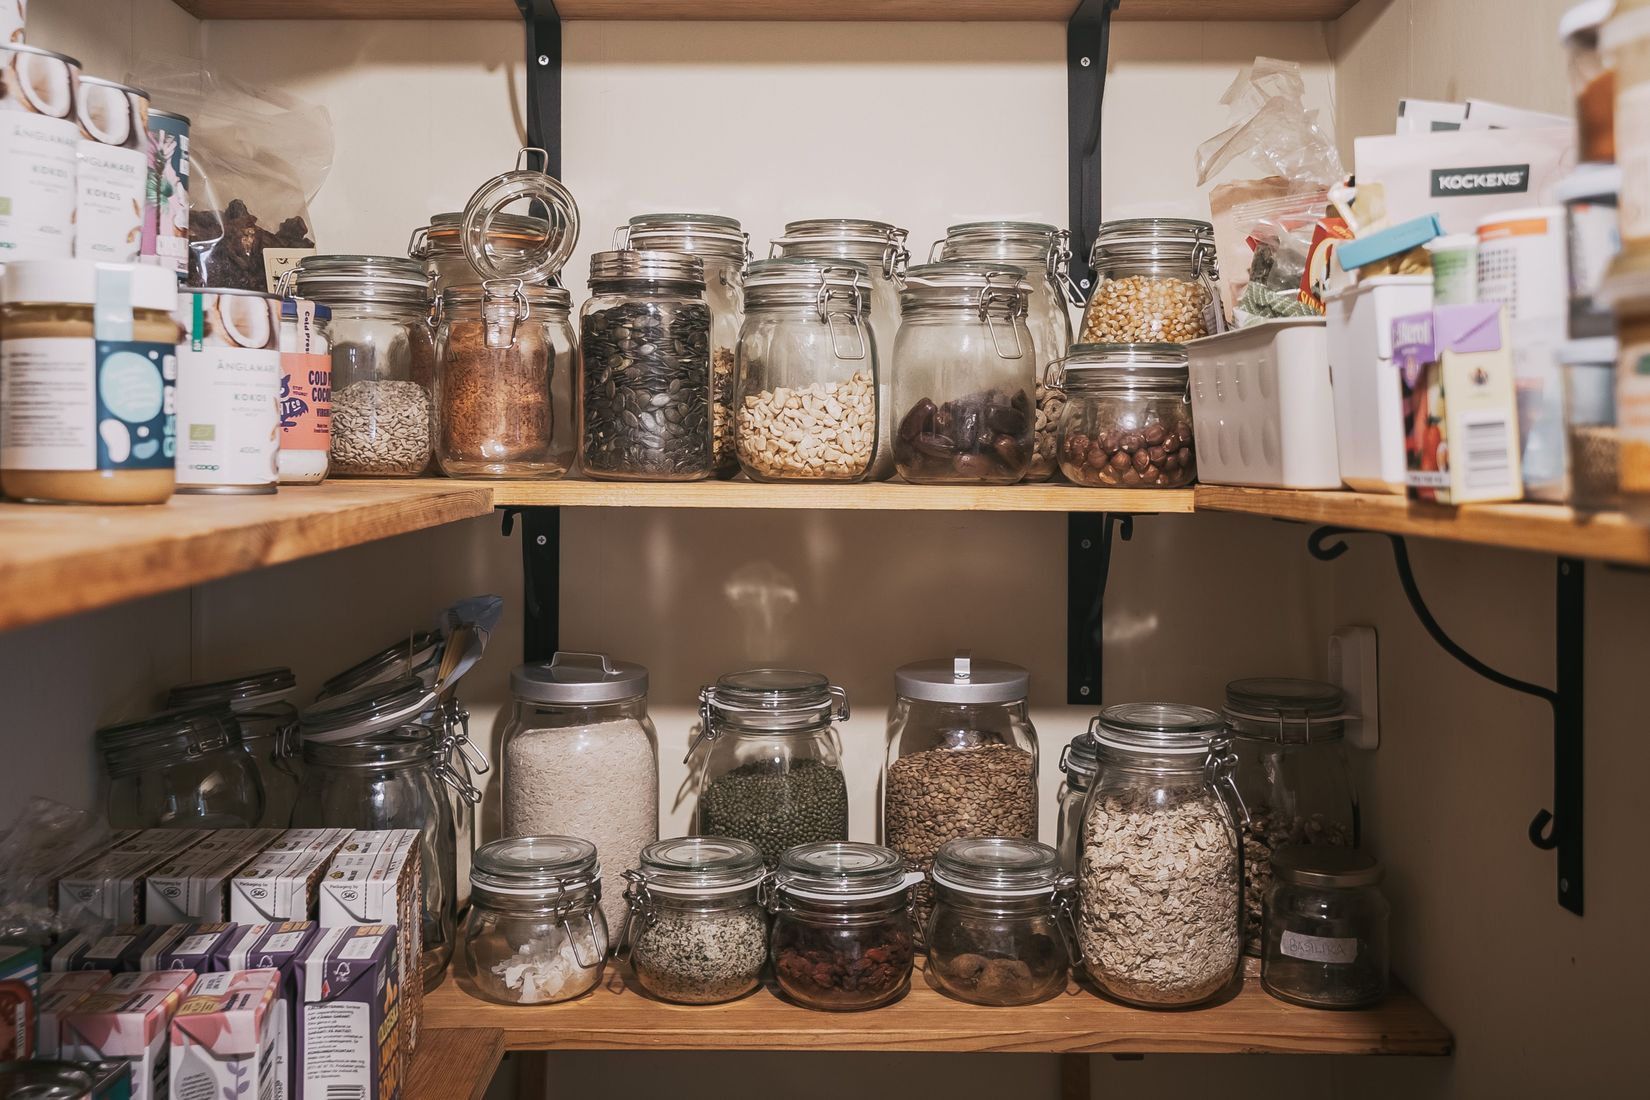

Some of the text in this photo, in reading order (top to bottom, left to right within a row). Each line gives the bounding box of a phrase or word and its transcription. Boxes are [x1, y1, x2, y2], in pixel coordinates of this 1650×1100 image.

[1438, 171, 1522, 190] KOCKENS
[86, 188, 121, 201] KOKOS
[304, 310, 312, 331] Cold
[308, 370, 328, 386] COLD
[251, 889, 265, 897] SIG
[343, 891, 356, 899] SIG
